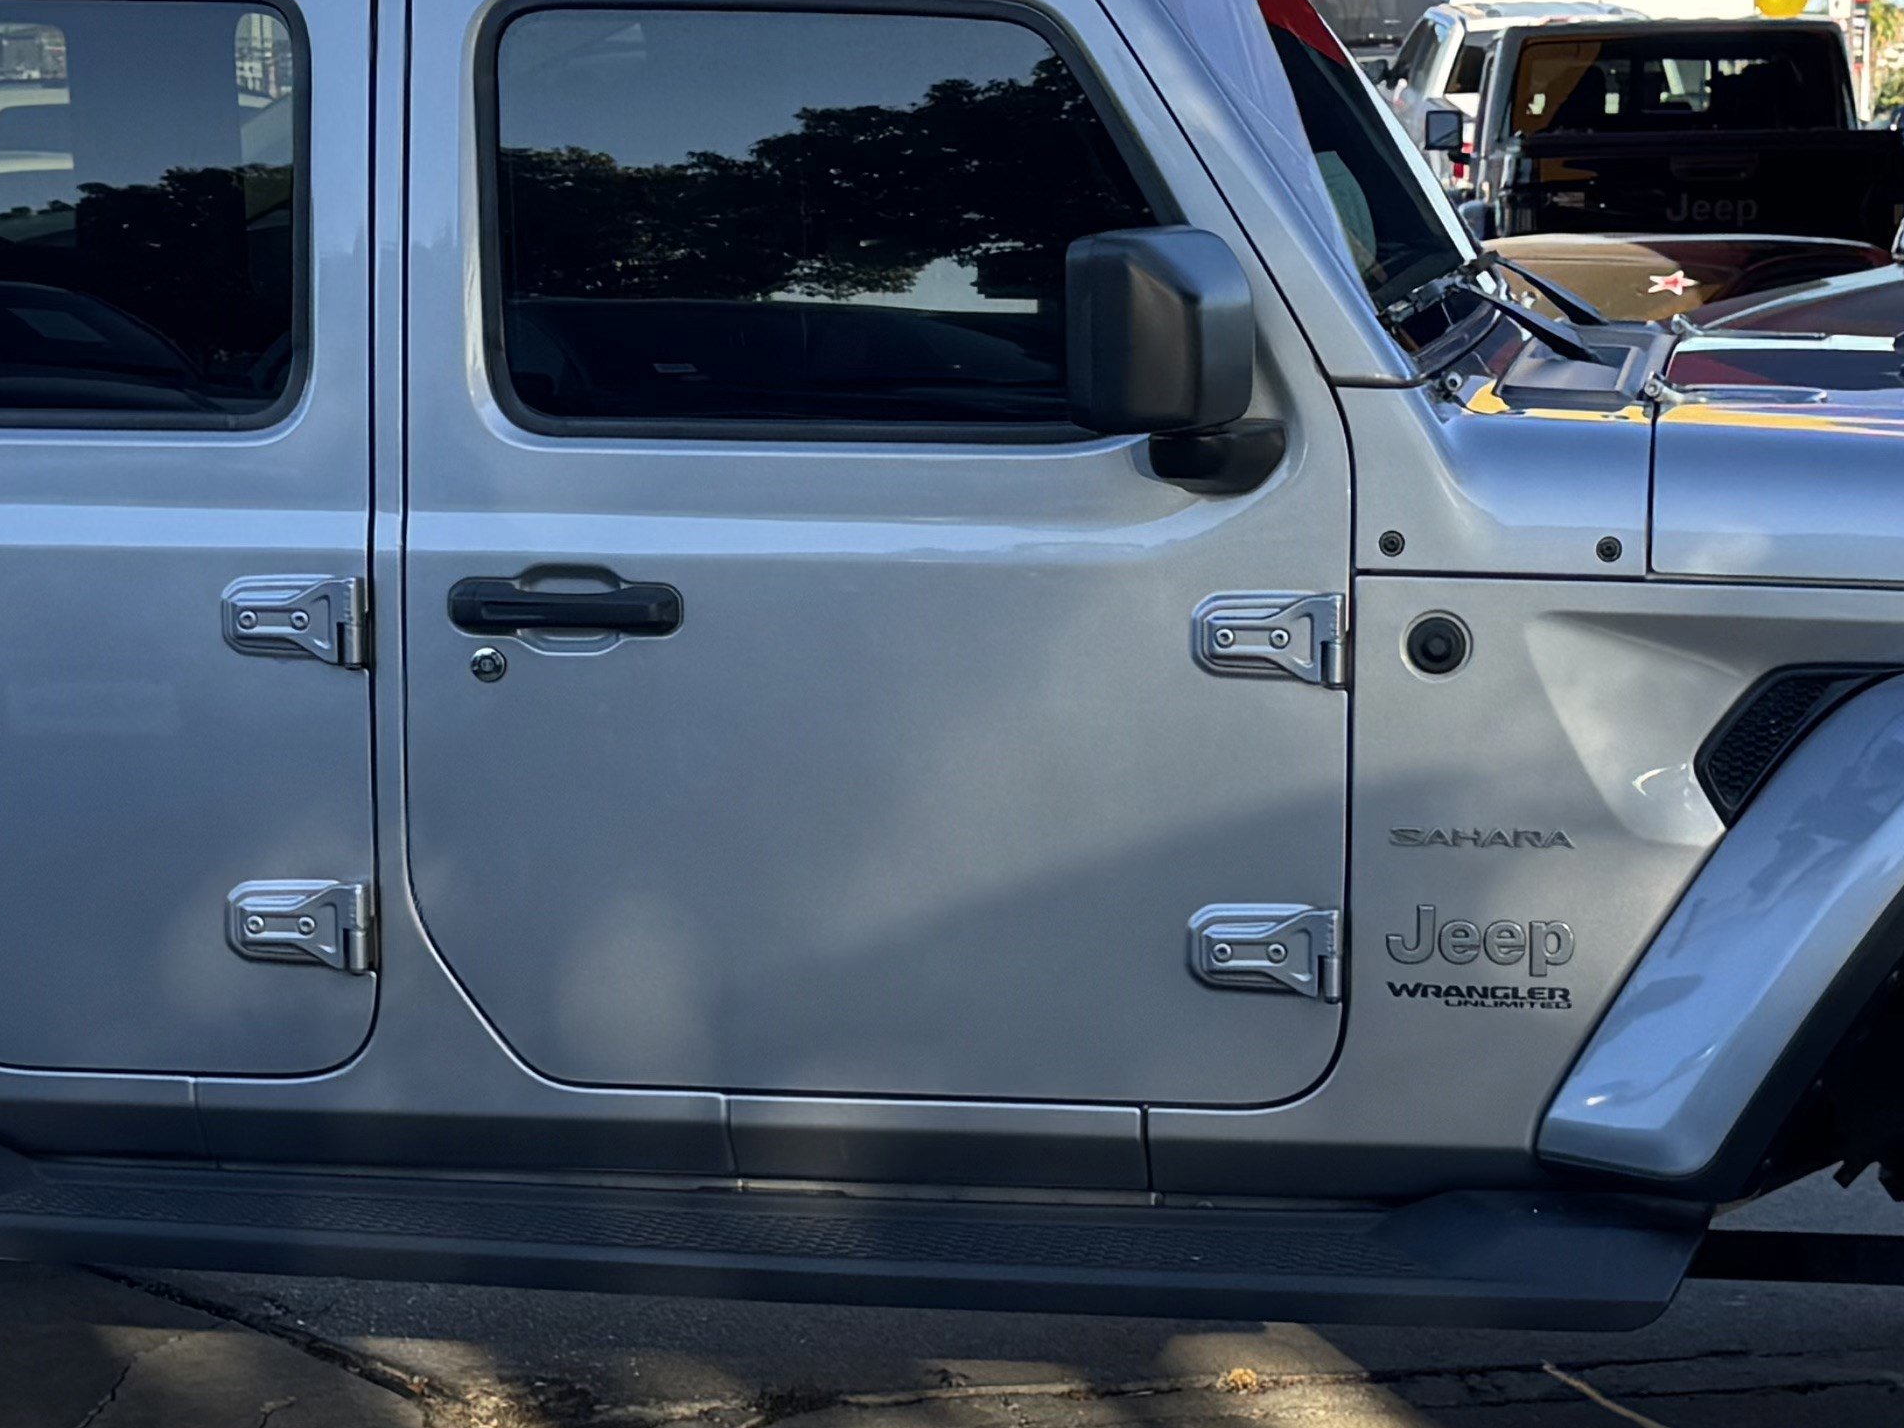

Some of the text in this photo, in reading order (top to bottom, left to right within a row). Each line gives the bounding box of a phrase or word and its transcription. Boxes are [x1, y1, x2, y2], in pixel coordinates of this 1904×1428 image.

[1665, 192, 1758, 228] Jeep
[1389, 827, 1576, 849] SAHARA
[1386, 904, 1575, 977] Jeep
[1386, 982, 1571, 1001] WRANGLER
[1443, 999, 1572, 1009] UNLIMITED
